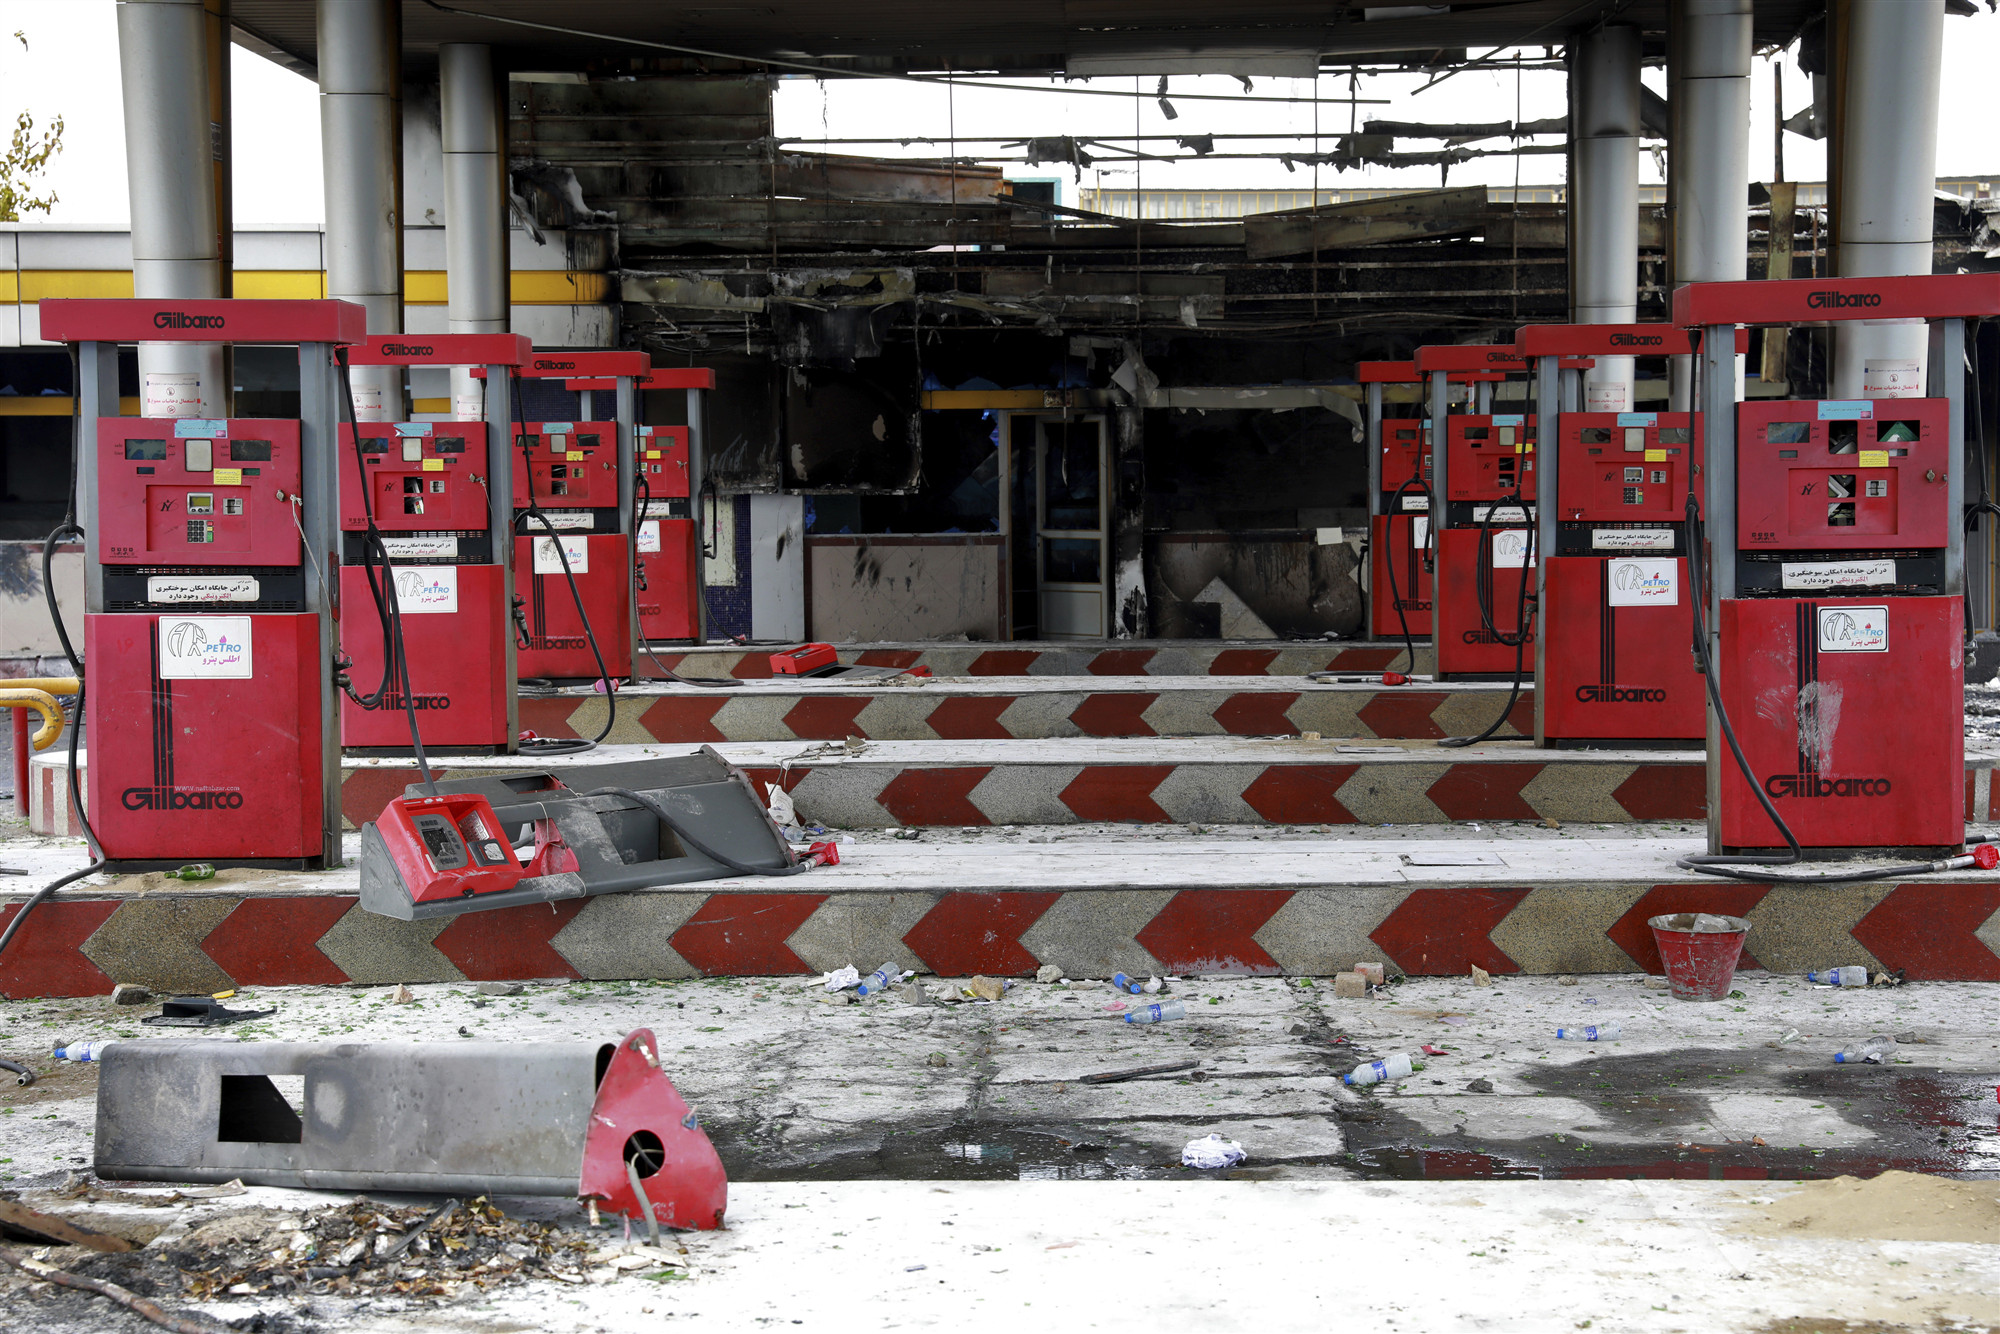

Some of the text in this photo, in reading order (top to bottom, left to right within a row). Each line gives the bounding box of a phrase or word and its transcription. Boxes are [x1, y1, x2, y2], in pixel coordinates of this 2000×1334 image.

[1807, 291, 1881, 309] Gilbarco
[153, 312, 225, 329] Gilbarco
[1609, 333, 1663, 346] Gilbarco
[381, 343, 434, 356] Gilbarco
[534, 360, 575, 370] Gilbarco
[202, 655, 240, 666] اطلس پترو
[1575, 685, 1666, 703] Gilbarco
[1765, 774, 1891, 798] Gilbarco
[121, 787, 243, 811] Gilbarco
